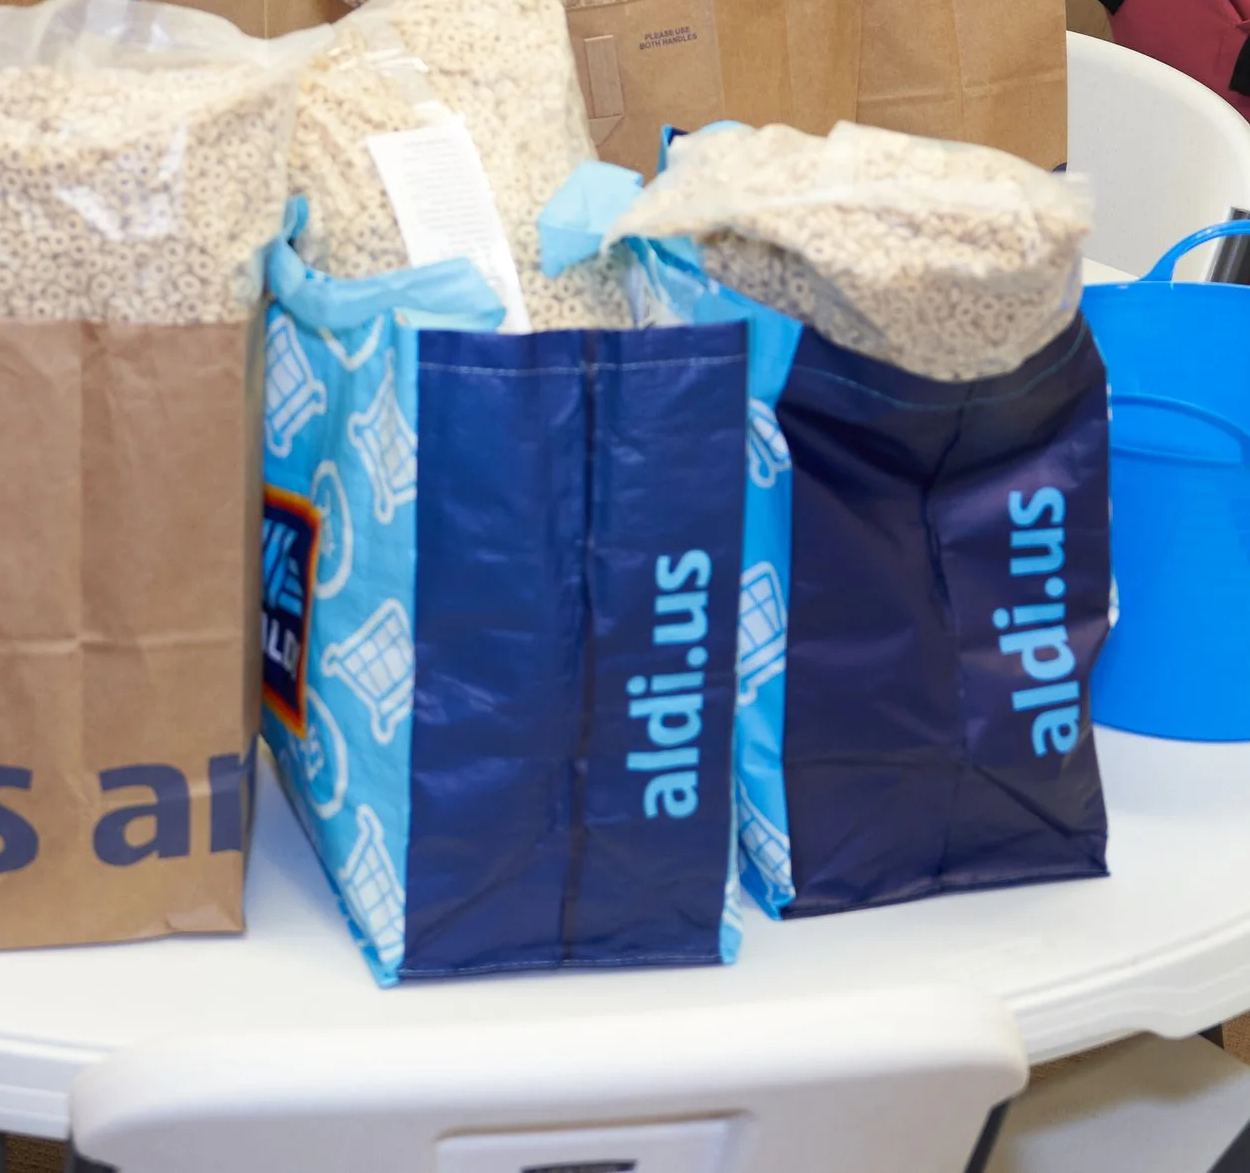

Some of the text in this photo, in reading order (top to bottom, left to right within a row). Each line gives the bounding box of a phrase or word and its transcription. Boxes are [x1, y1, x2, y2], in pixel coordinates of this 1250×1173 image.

[639, 33, 697, 50] BOTH HANDLES
[644, 26, 690, 40] PLEASE USE
[625, 548, 712, 820] aldi.us
[992, 485, 1081, 757] aldi.us
